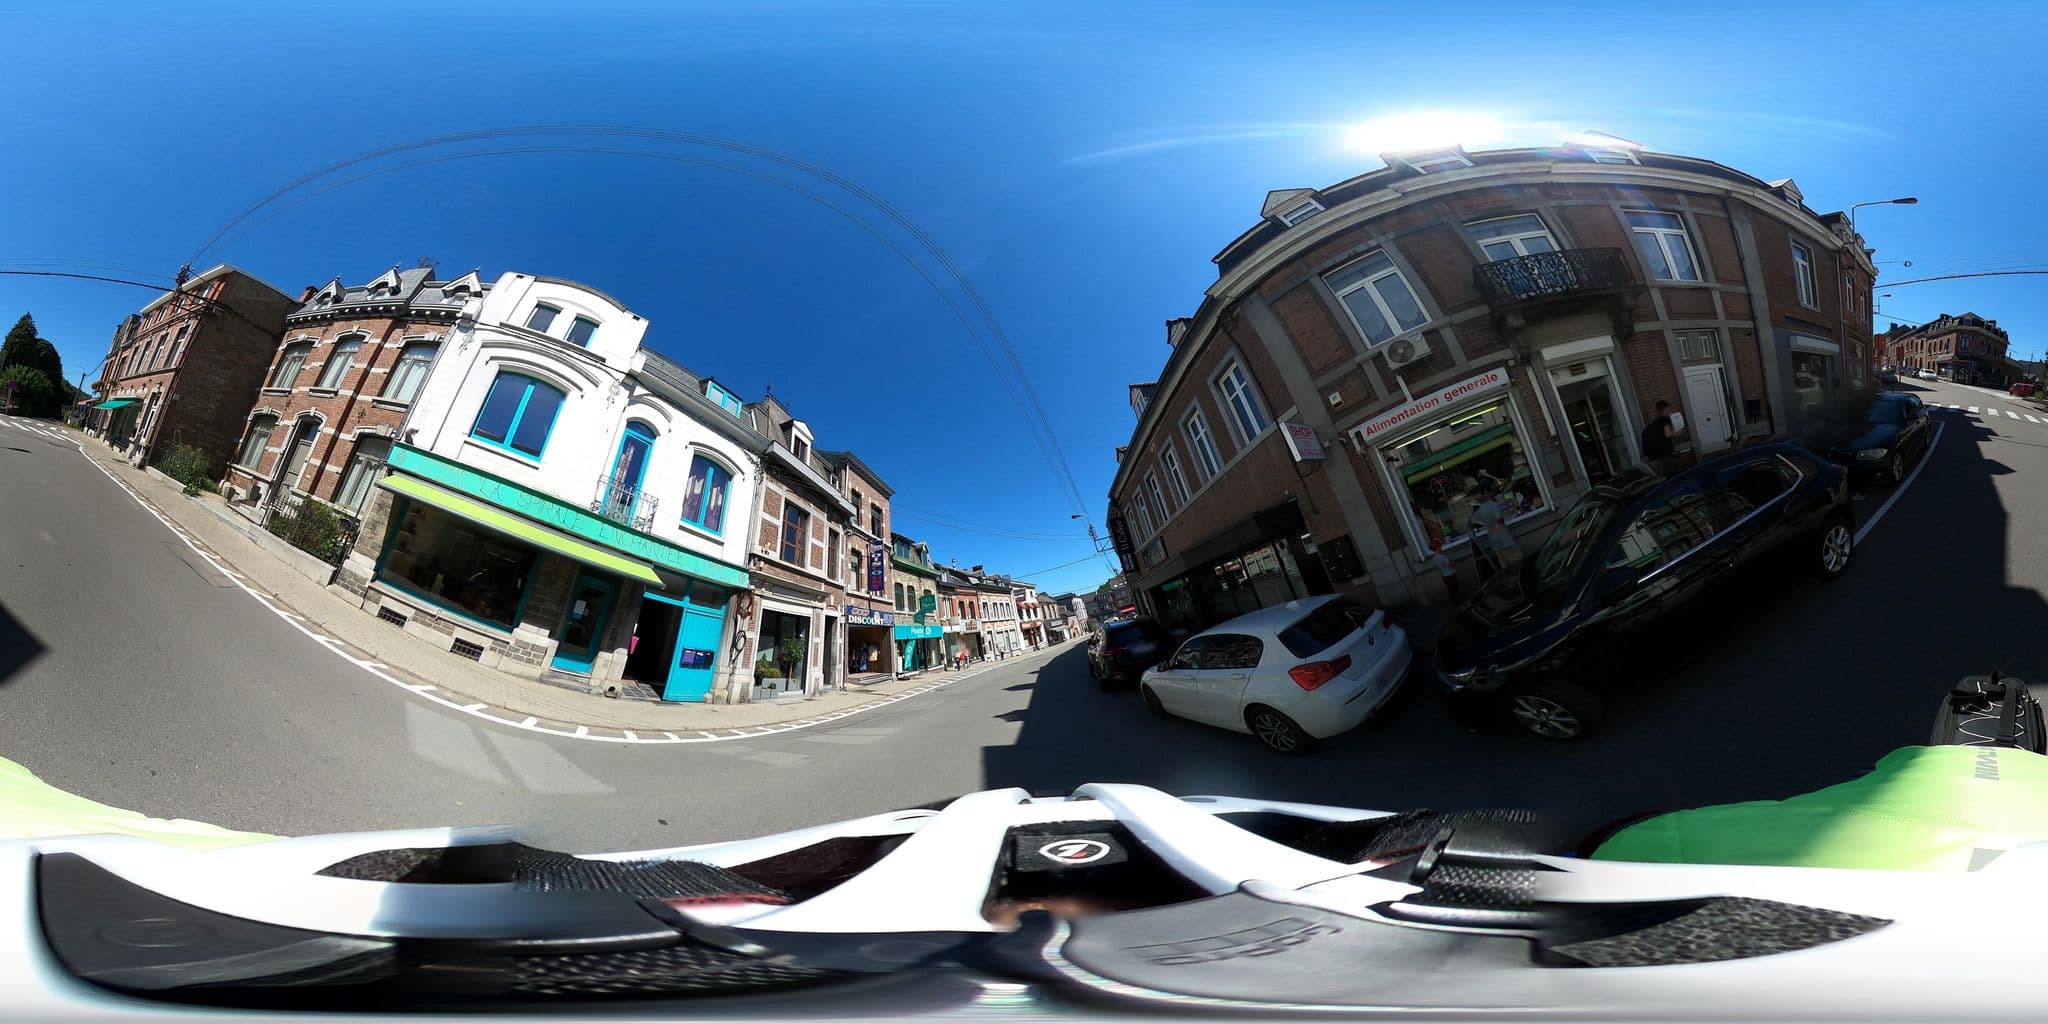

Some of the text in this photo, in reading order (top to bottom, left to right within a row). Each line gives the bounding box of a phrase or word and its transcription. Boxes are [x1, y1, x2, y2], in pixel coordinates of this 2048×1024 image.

[1365, 372, 1499, 437] Alimentation generale
[848, 614, 884, 626] DISCOUNT
